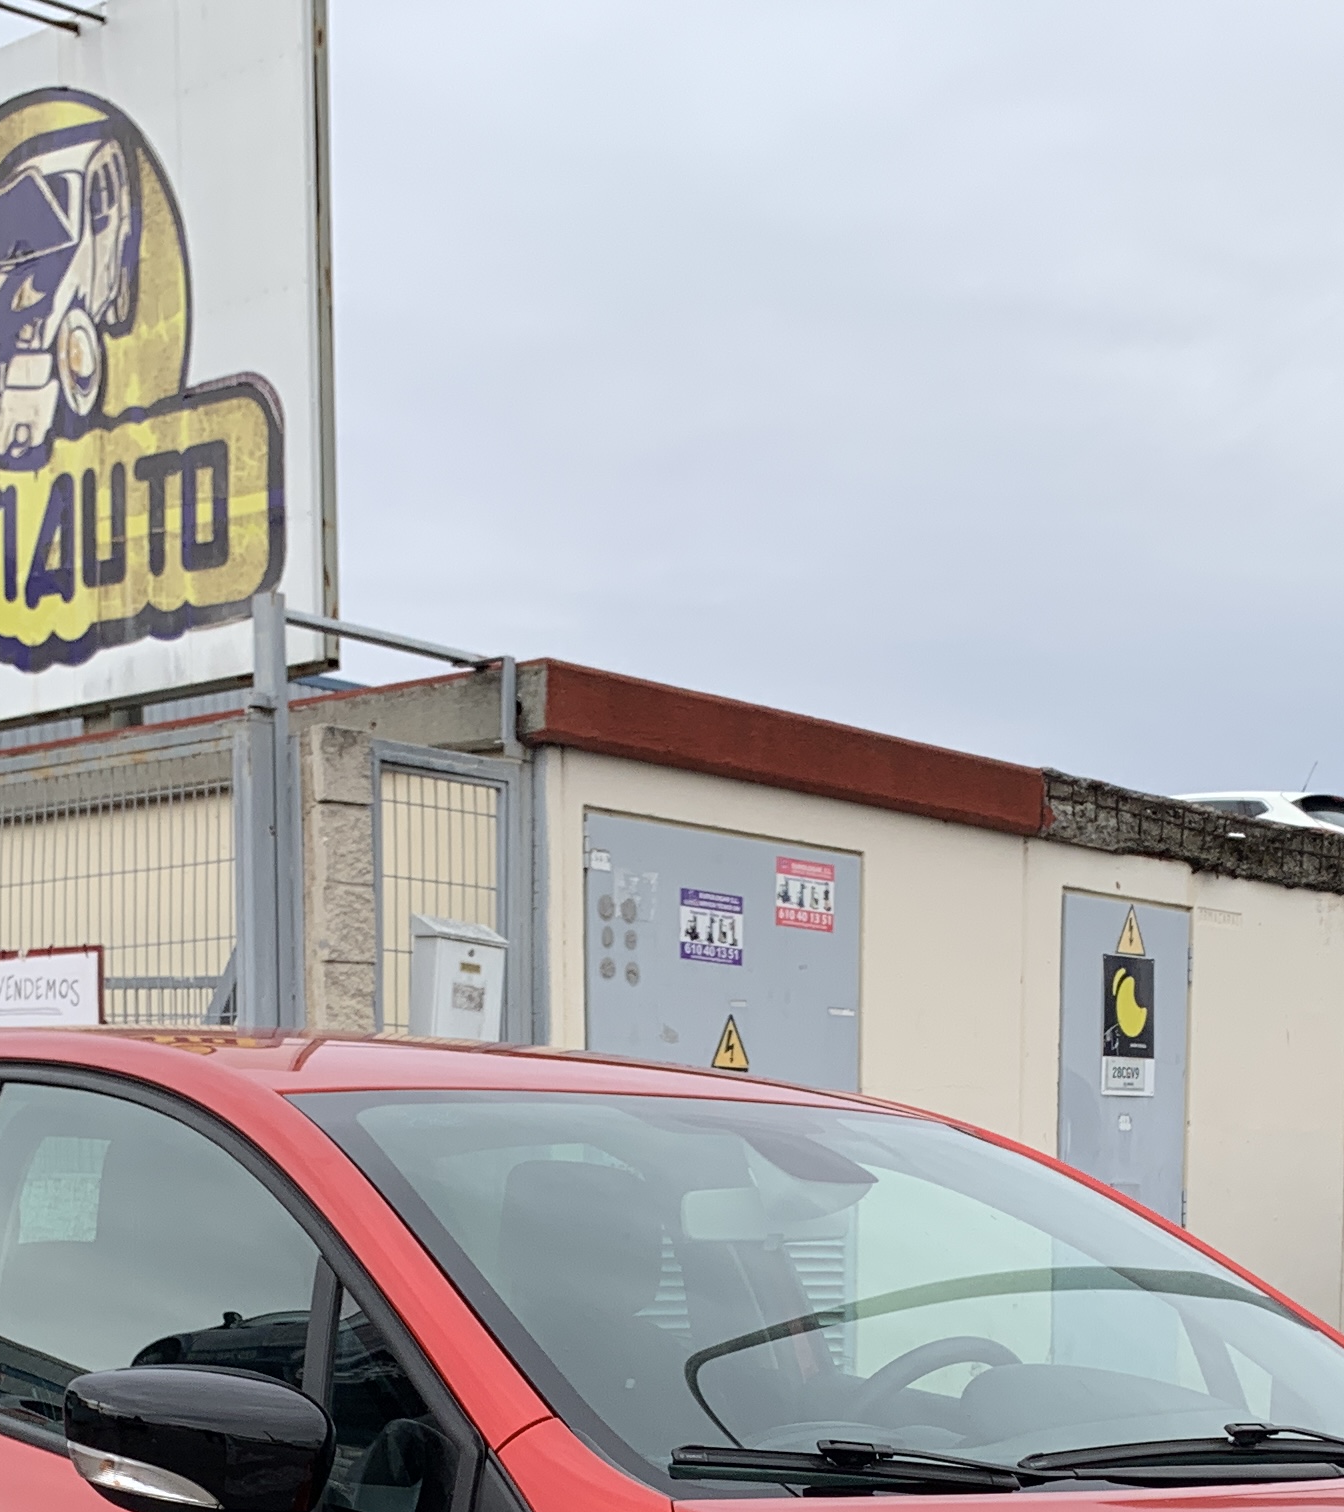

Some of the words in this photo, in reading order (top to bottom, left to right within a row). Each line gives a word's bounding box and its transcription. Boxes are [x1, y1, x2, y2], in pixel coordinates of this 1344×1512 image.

[684, 943, 702, 955] 610
[703, 945, 716, 957] 40
[717, 946, 727, 958] 13
[728, 948, 739, 960] 51
